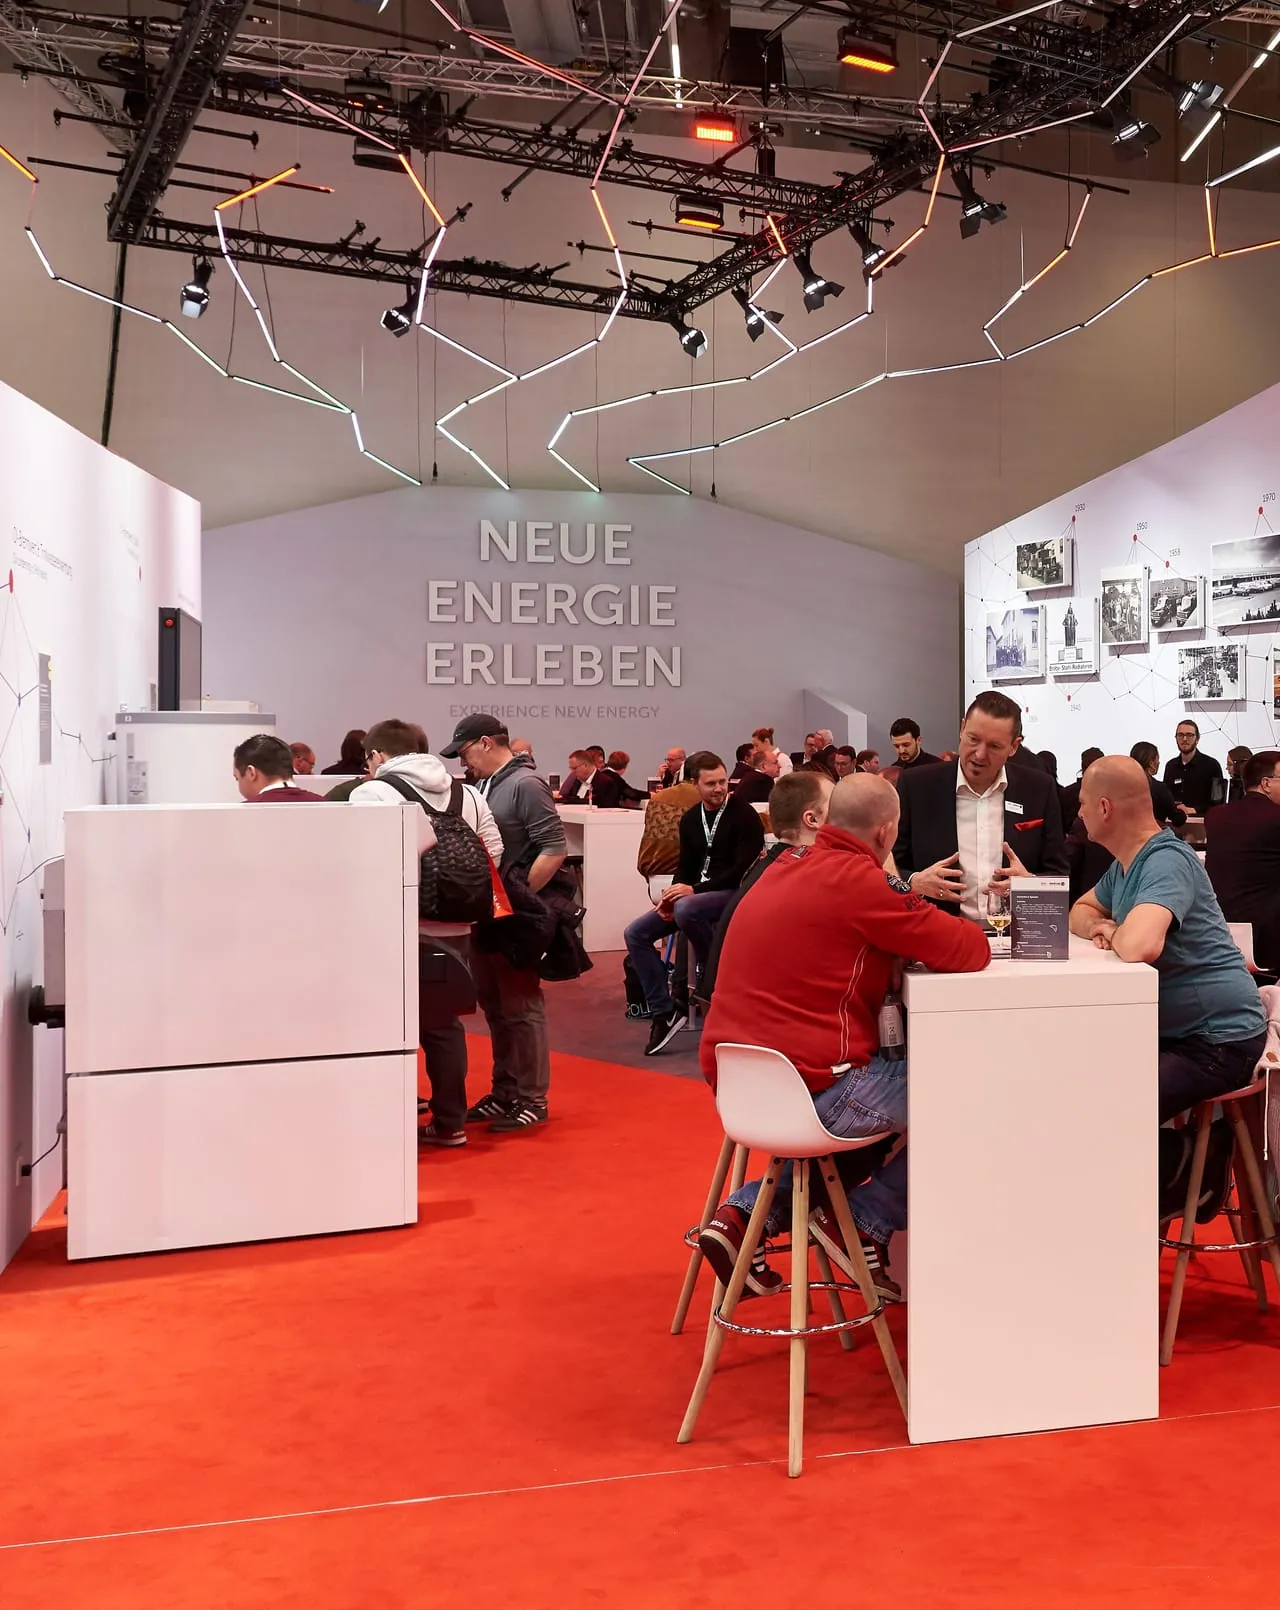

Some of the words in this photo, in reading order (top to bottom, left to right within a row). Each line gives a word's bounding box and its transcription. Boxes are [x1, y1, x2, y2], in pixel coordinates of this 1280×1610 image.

[1262, 492, 1276, 503] 1970
[480, 519, 633, 565] NEUE
[428, 580, 677, 627] ENERGIE
[426, 642, 682, 688] ERLEBEN
[450, 704, 549, 718] EXPERIENCE
[555, 706, 592, 718] NEW
[597, 706, 660, 719] ENERGY
